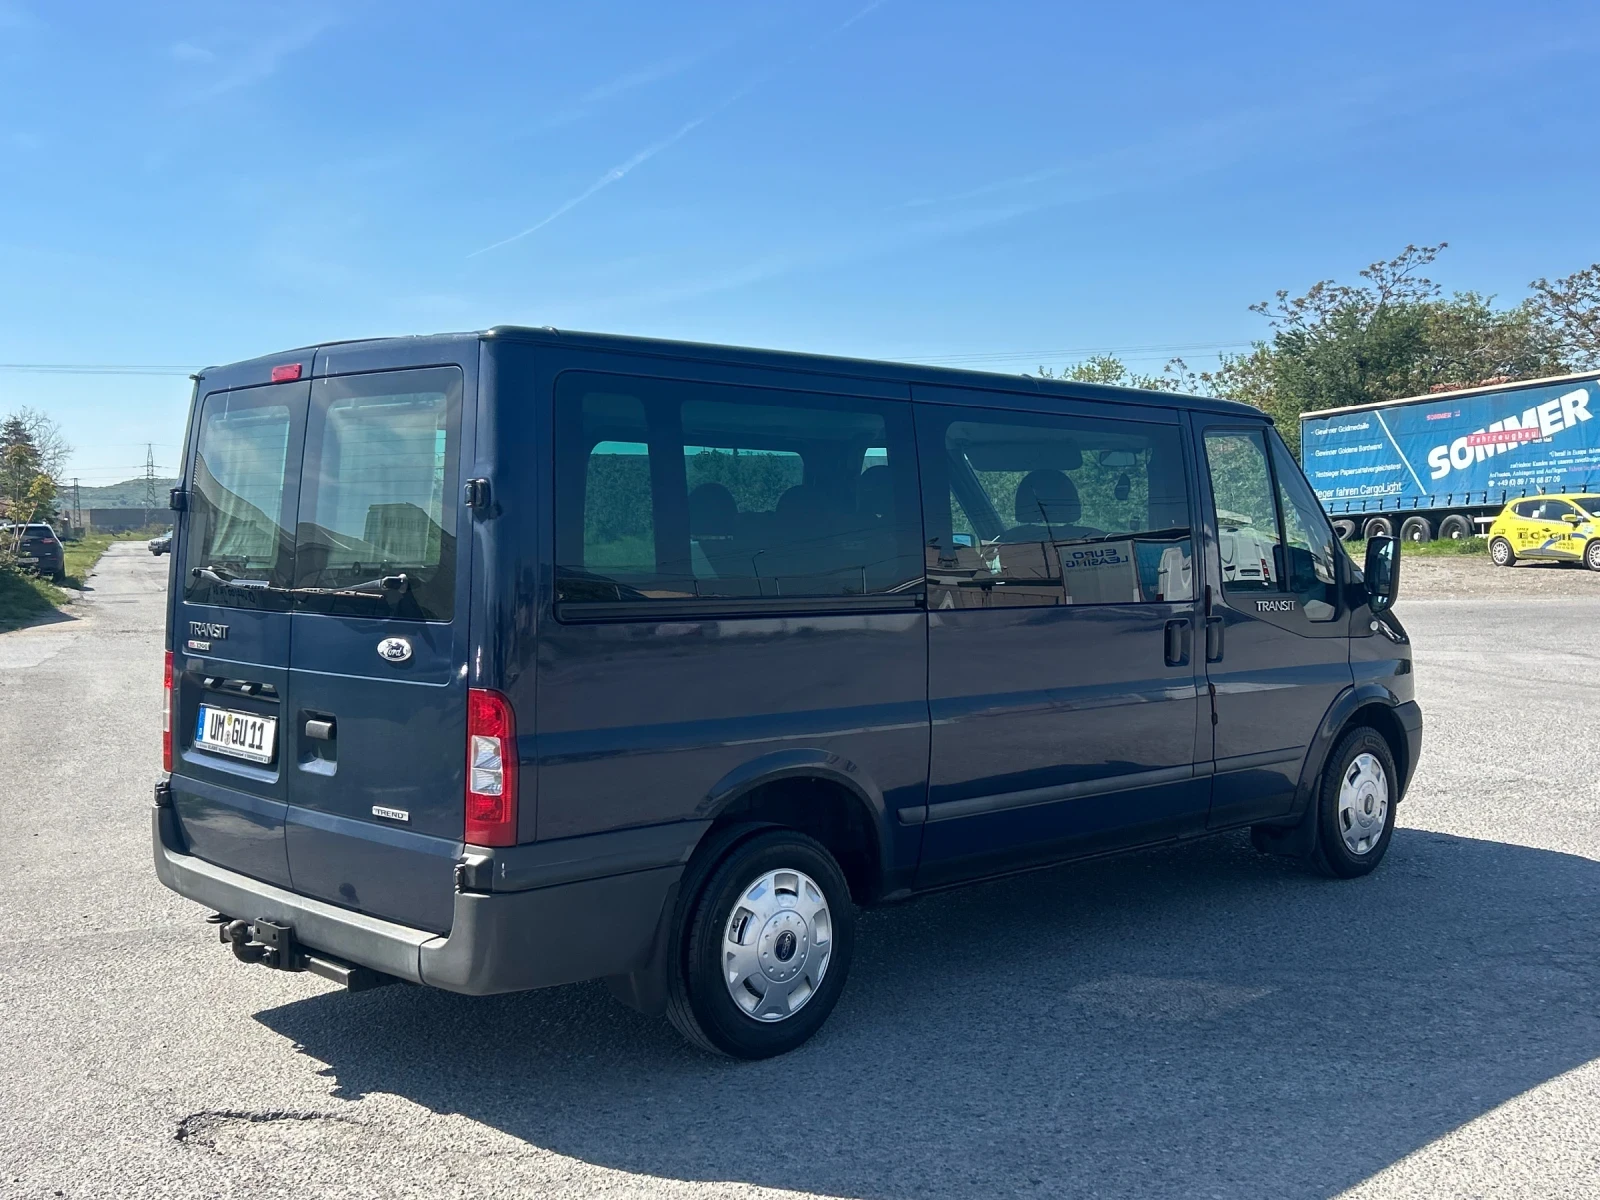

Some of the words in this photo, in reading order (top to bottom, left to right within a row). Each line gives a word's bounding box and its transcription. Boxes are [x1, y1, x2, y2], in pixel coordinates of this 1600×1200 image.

[1427, 388, 1593, 480] SOMMER
[1469, 429, 1537, 444] Fahrzeugbau
[1315, 448, 1337, 457] Gewinner
[1336, 486, 1359, 496] fahren
[1360, 481, 1402, 497] CargoLight
[1256, 600, 1296, 612] TRANSIT
[189, 620, 229, 639] TRANSIT
[209, 713, 226, 742] UM
[231, 717, 249, 747] GU
[248, 720, 265, 751] 11
[377, 808, 405, 819] TREND
